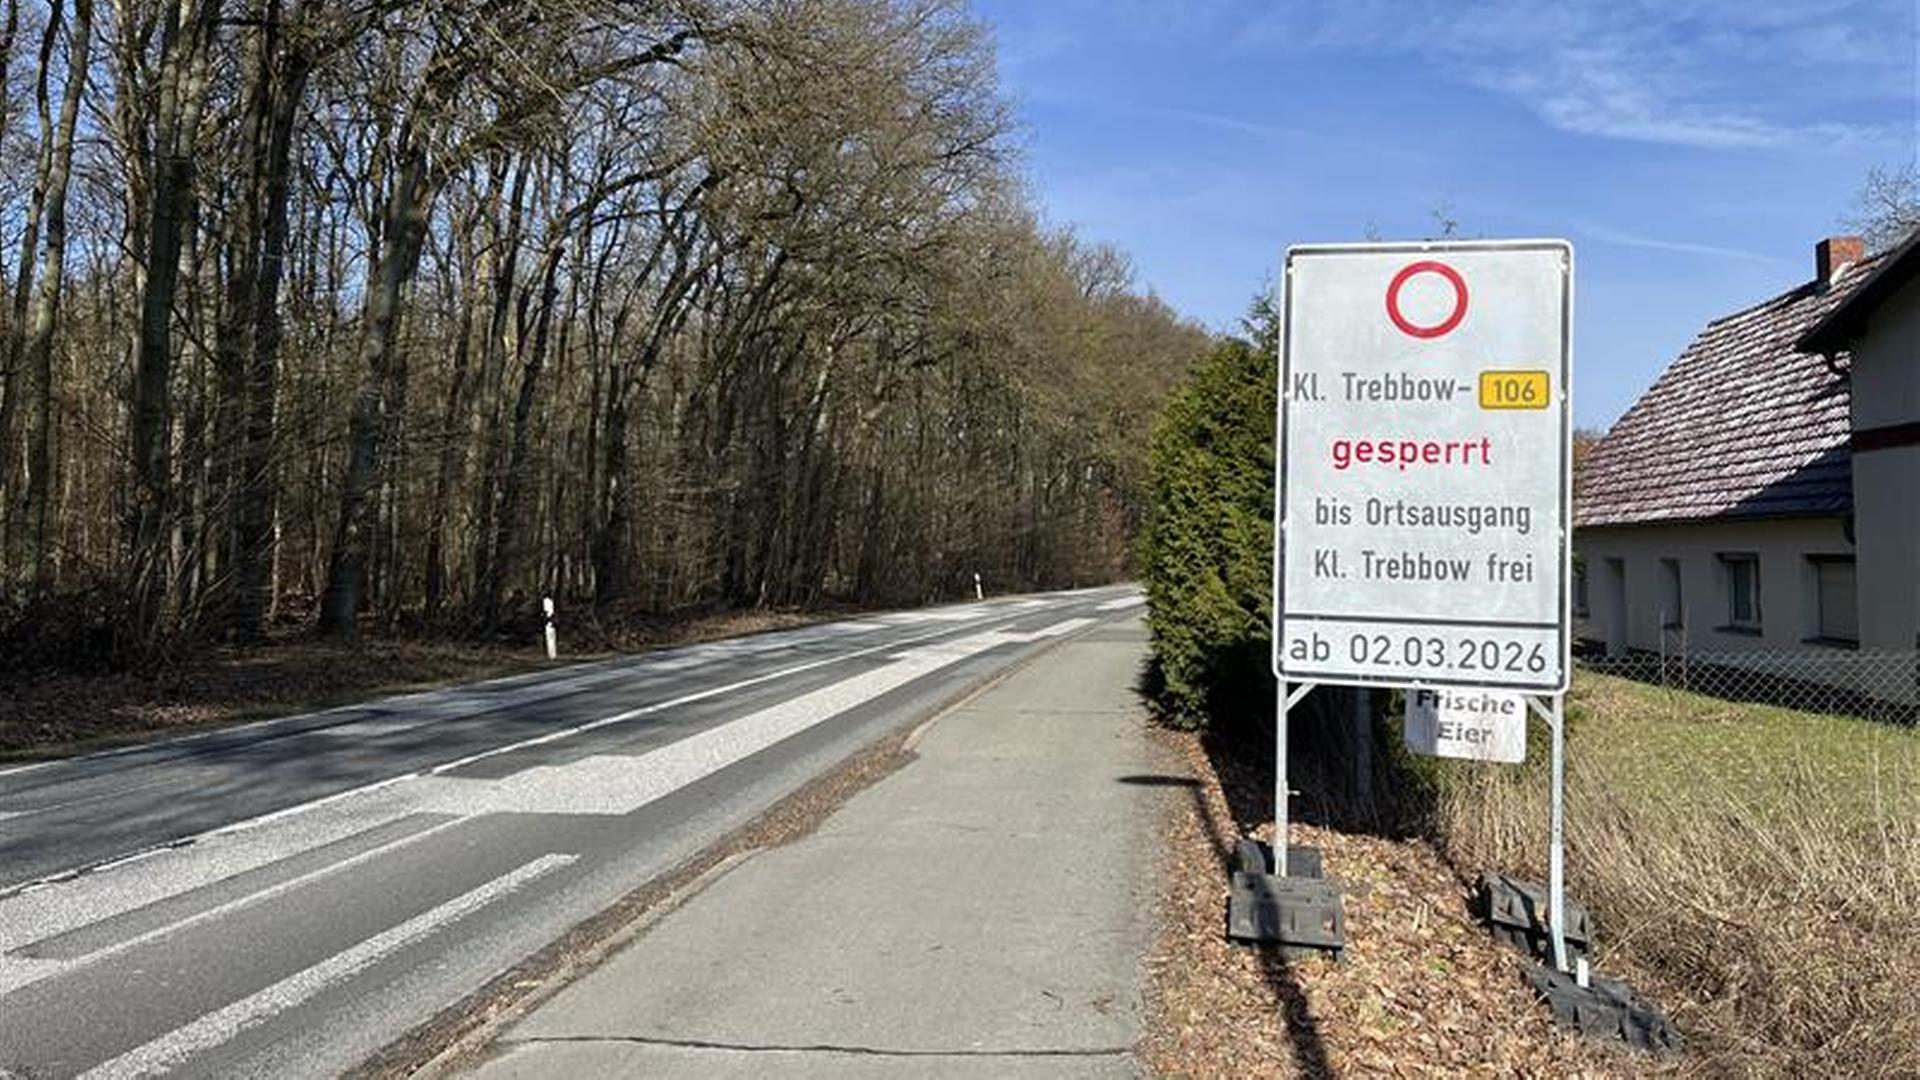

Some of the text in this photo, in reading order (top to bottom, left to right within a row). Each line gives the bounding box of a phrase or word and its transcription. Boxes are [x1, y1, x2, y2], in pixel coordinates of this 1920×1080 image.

[1294, 373, 1536, 402] Kl. Trebbow- 106
[1332, 437, 1492, 471] gesperrt
[1315, 498, 1531, 535] bis Ortsausgang
[1314, 549, 1533, 582] Kl. Trebbow frei
[1290, 633, 1546, 673] ab 02.03.2026
[1417, 688, 1516, 715] Frische
[1437, 721, 1493, 743] Eier
